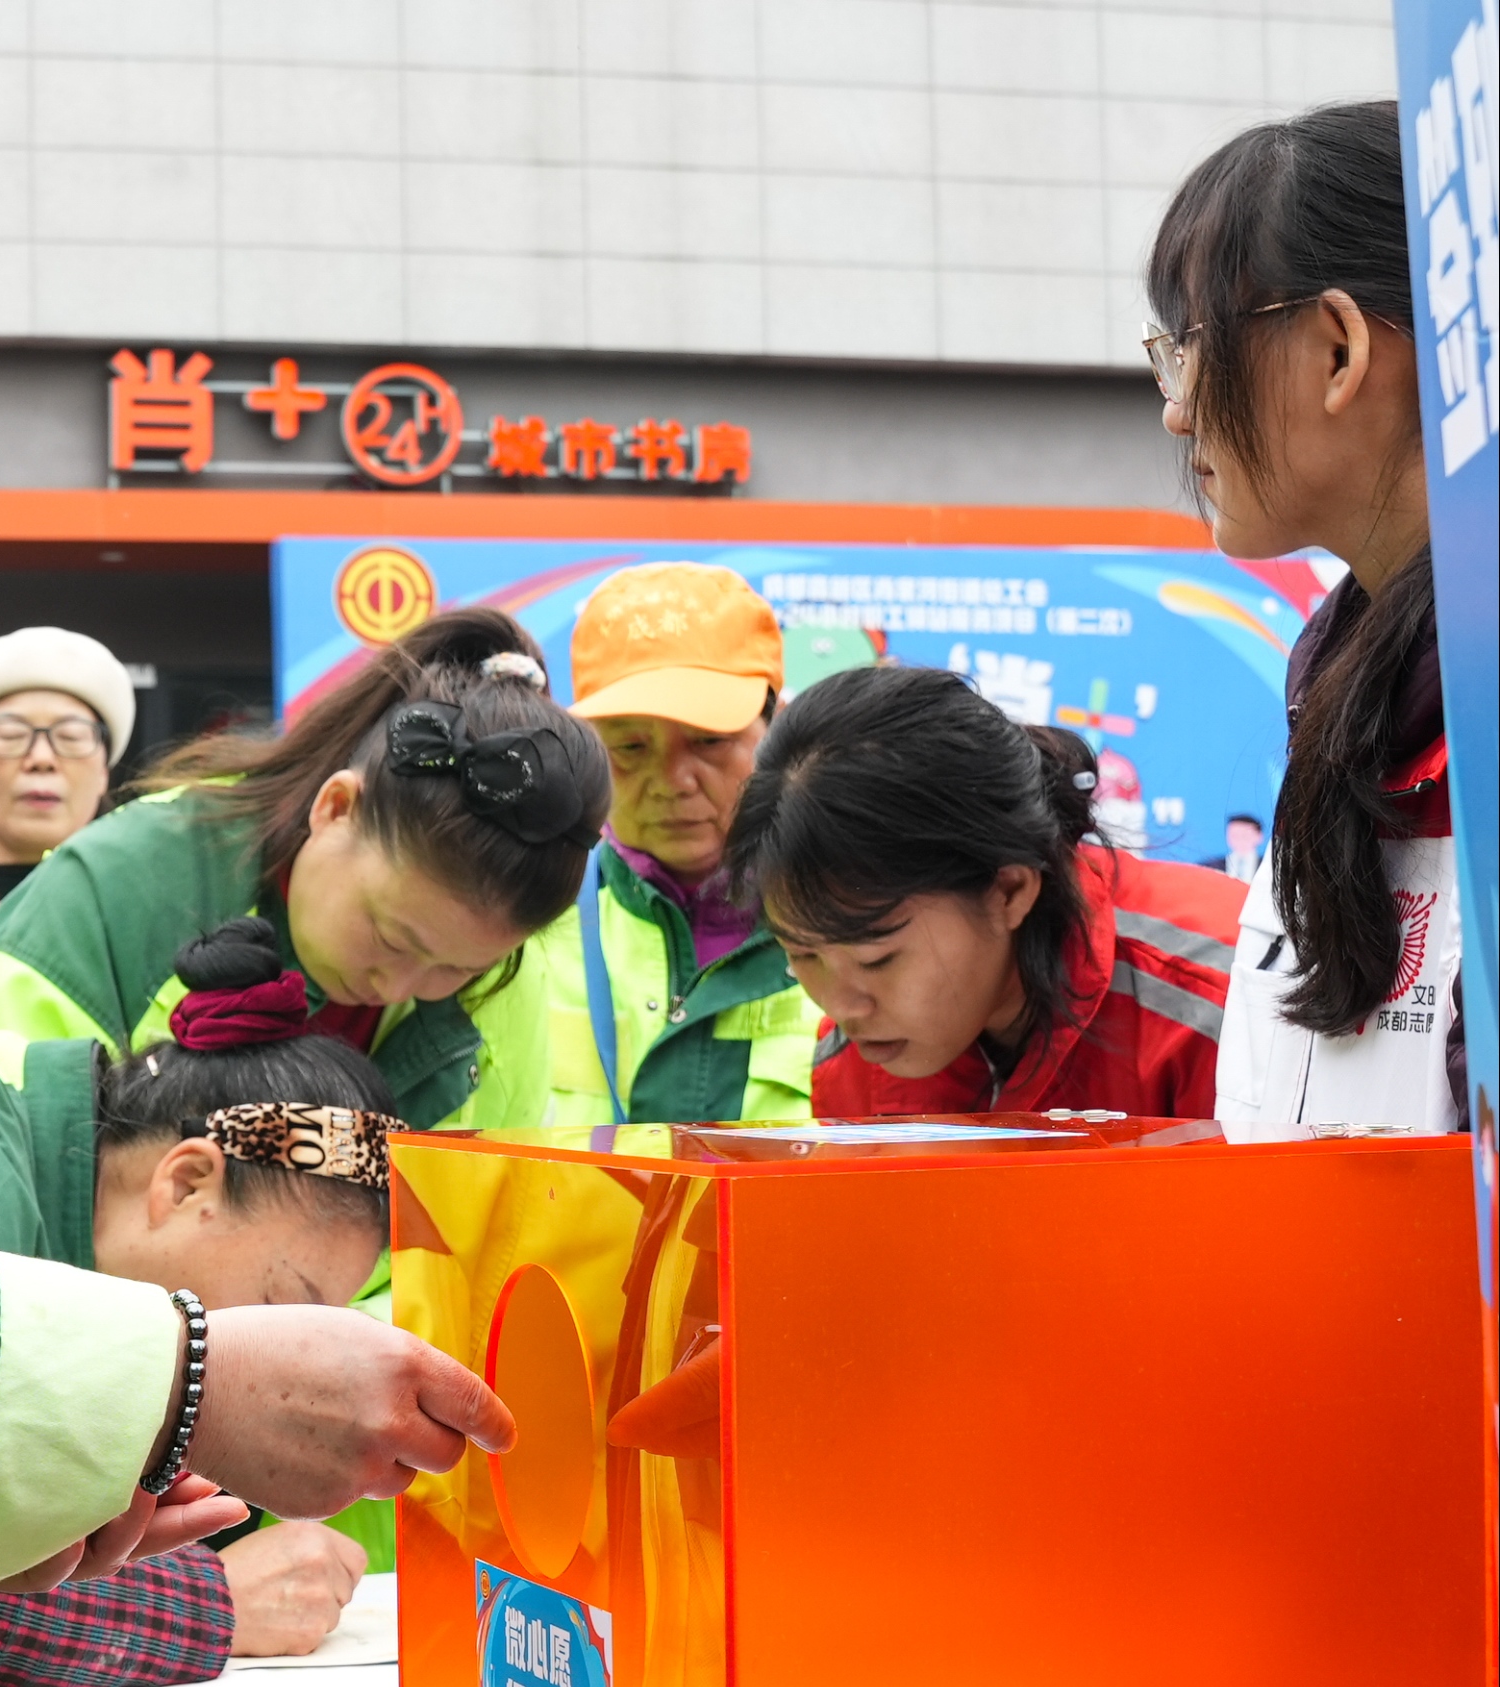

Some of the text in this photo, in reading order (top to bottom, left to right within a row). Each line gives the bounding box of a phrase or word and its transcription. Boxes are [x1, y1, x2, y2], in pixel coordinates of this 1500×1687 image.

[488, 415, 751, 483] 城市书房
[505, 1605, 572, 1687] 微心愿
